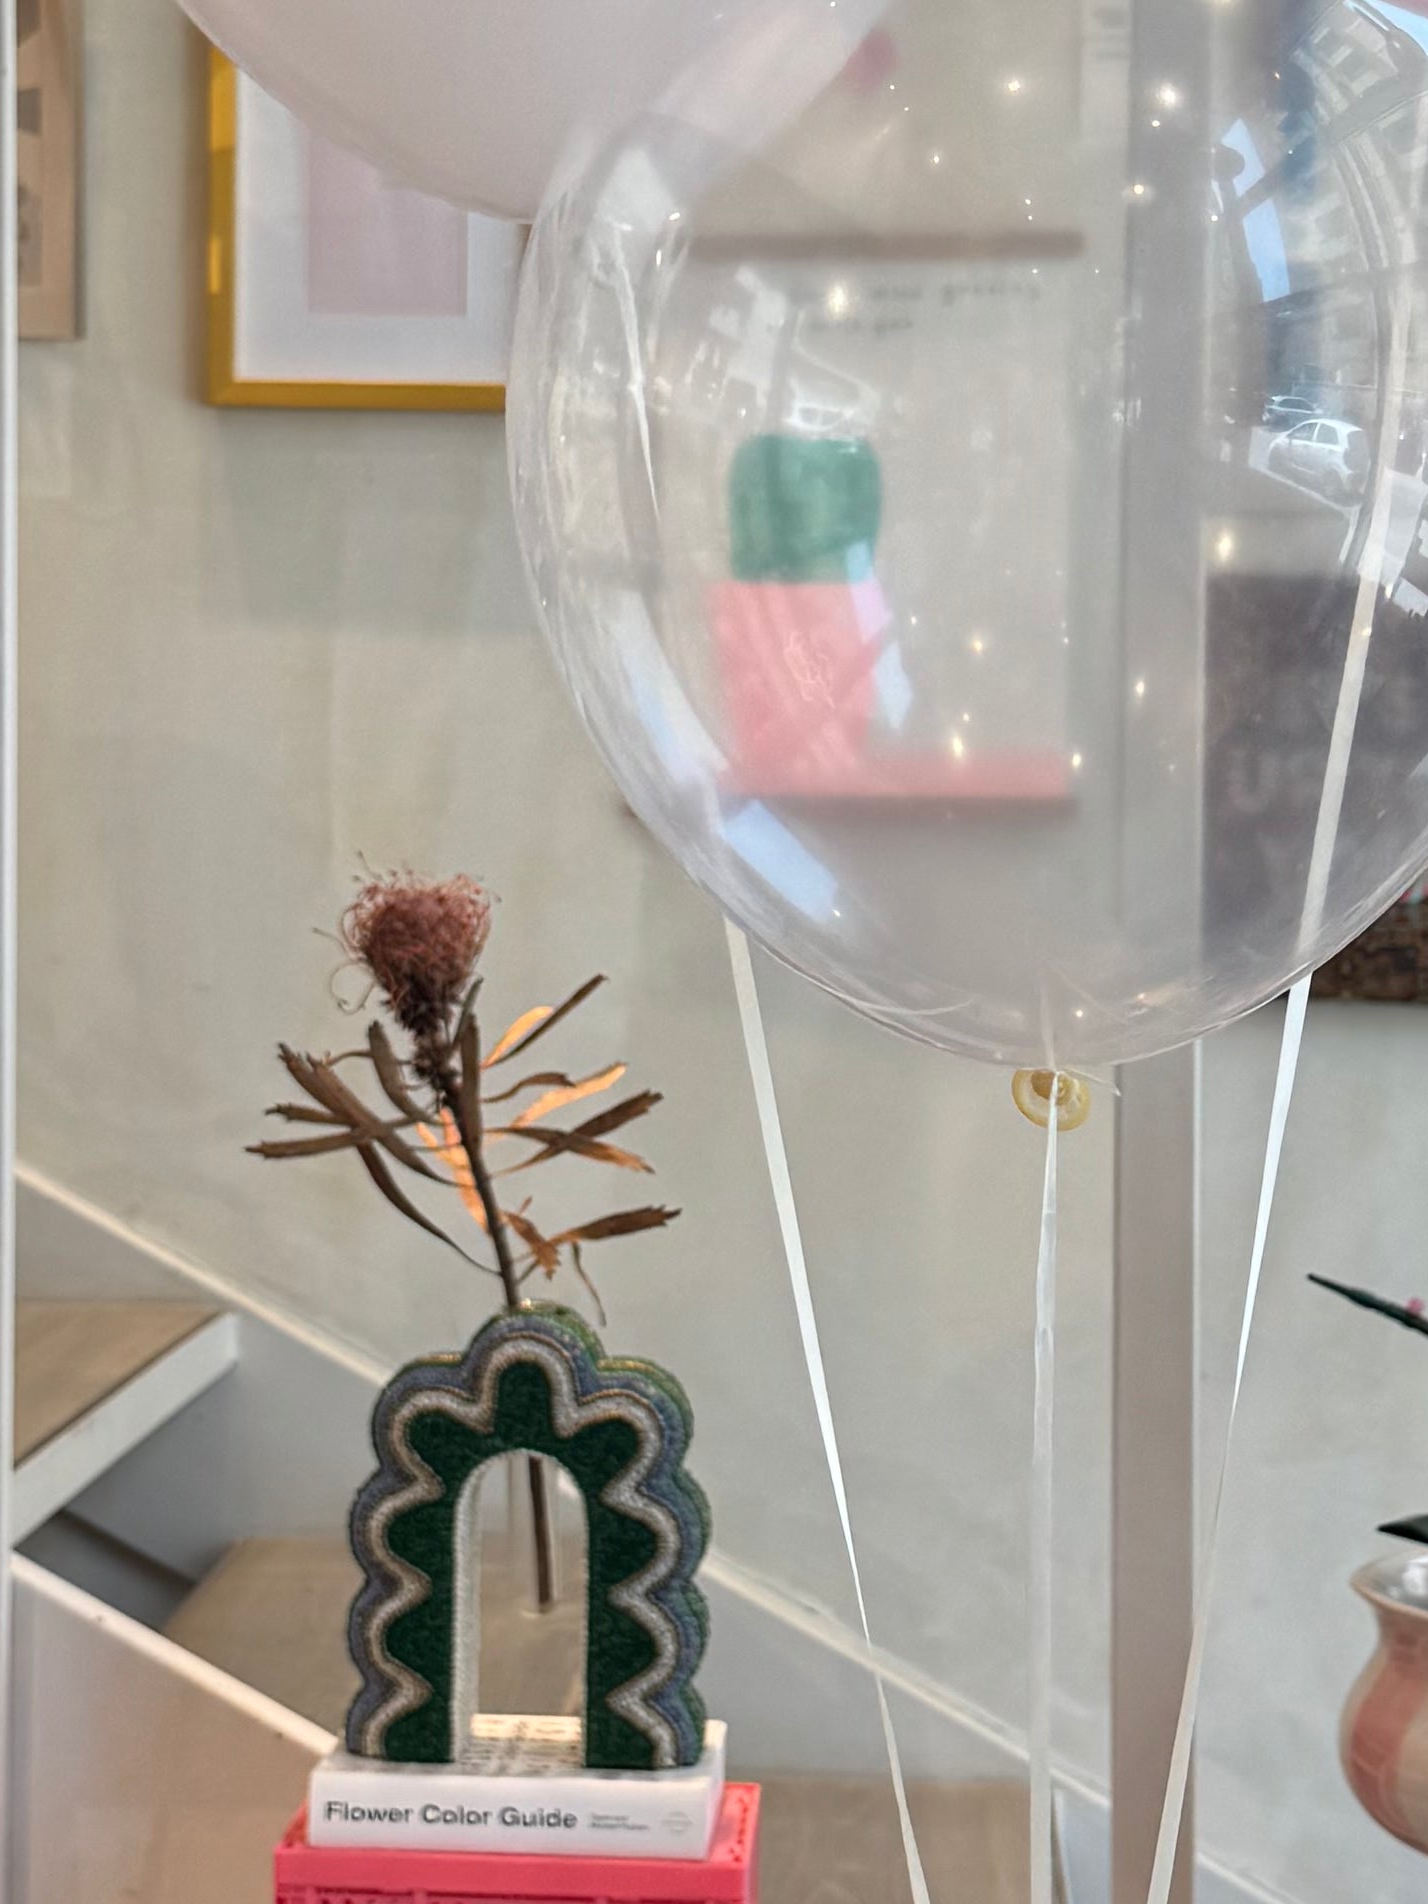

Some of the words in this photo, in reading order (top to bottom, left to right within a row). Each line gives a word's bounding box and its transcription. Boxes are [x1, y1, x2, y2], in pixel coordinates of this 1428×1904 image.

[325, 1800, 414, 1823] Flower
[421, 1803, 493, 1826] Color
[499, 1805, 578, 1829] Guide
